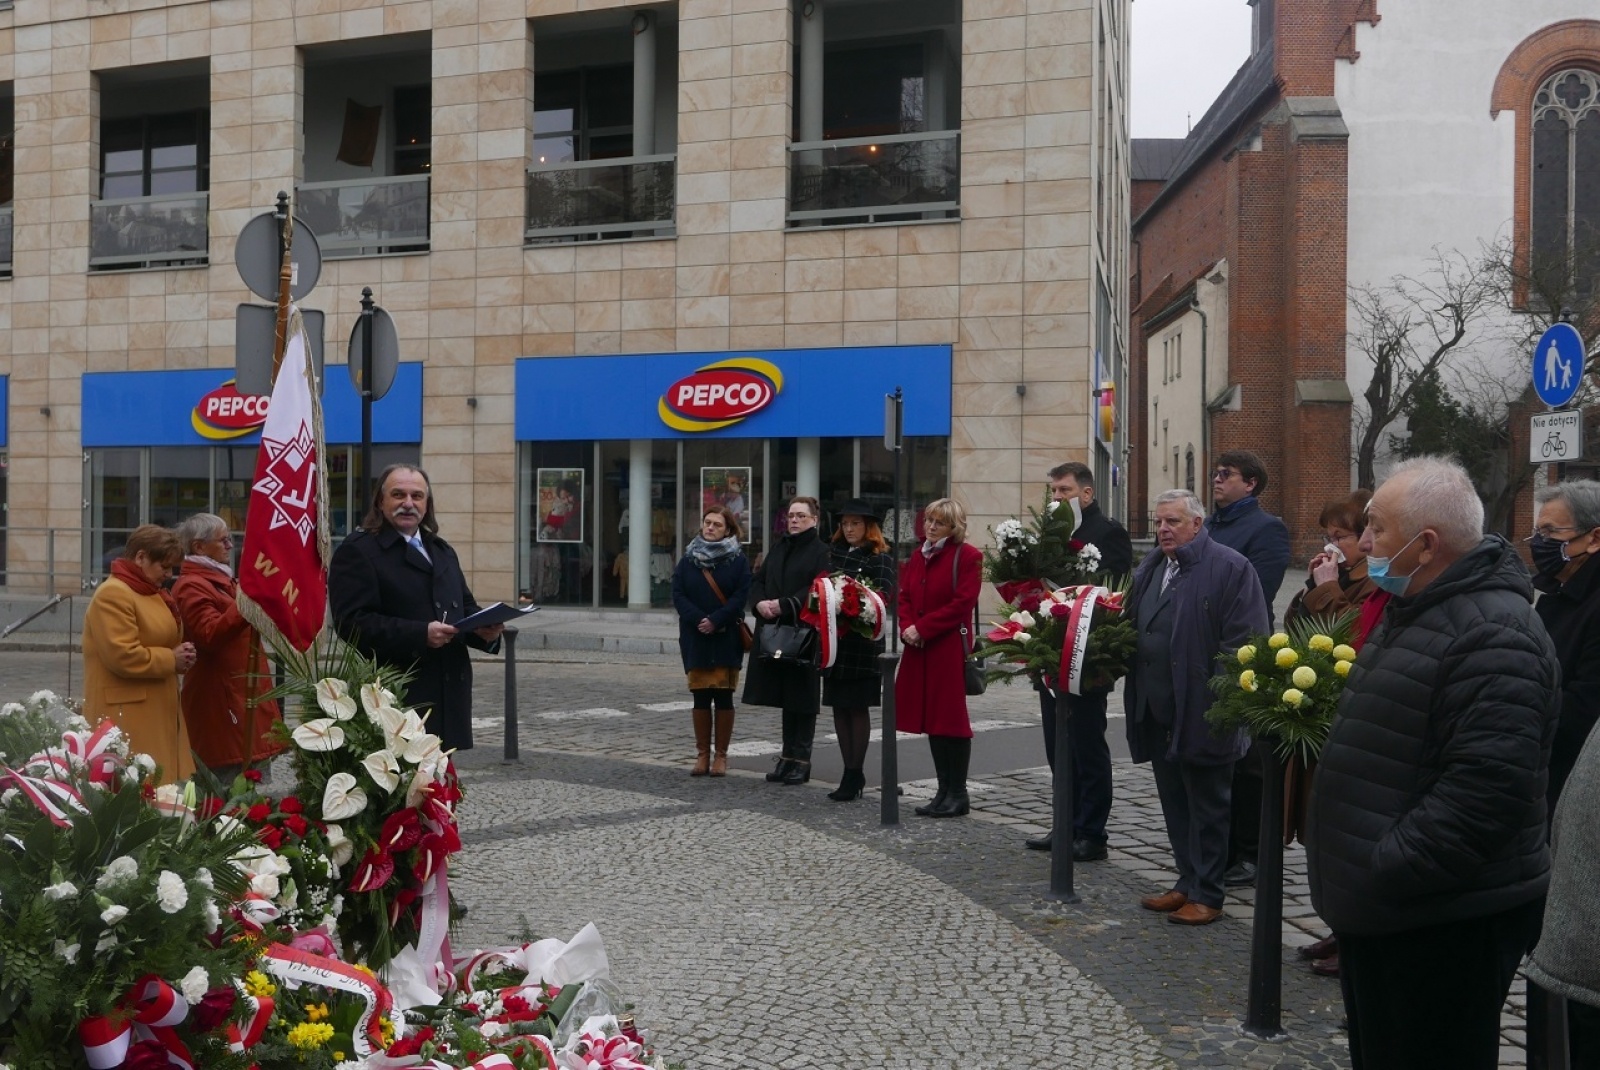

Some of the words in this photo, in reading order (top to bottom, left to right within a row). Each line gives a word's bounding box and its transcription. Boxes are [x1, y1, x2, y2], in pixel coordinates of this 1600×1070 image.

[677, 383, 762, 406] PEPCO
[206, 396, 271, 417] PEPCO
[1533, 418, 1545, 428] Nie
[1549, 416, 1577, 428] dotyczy
[254, 551, 280, 578] W
